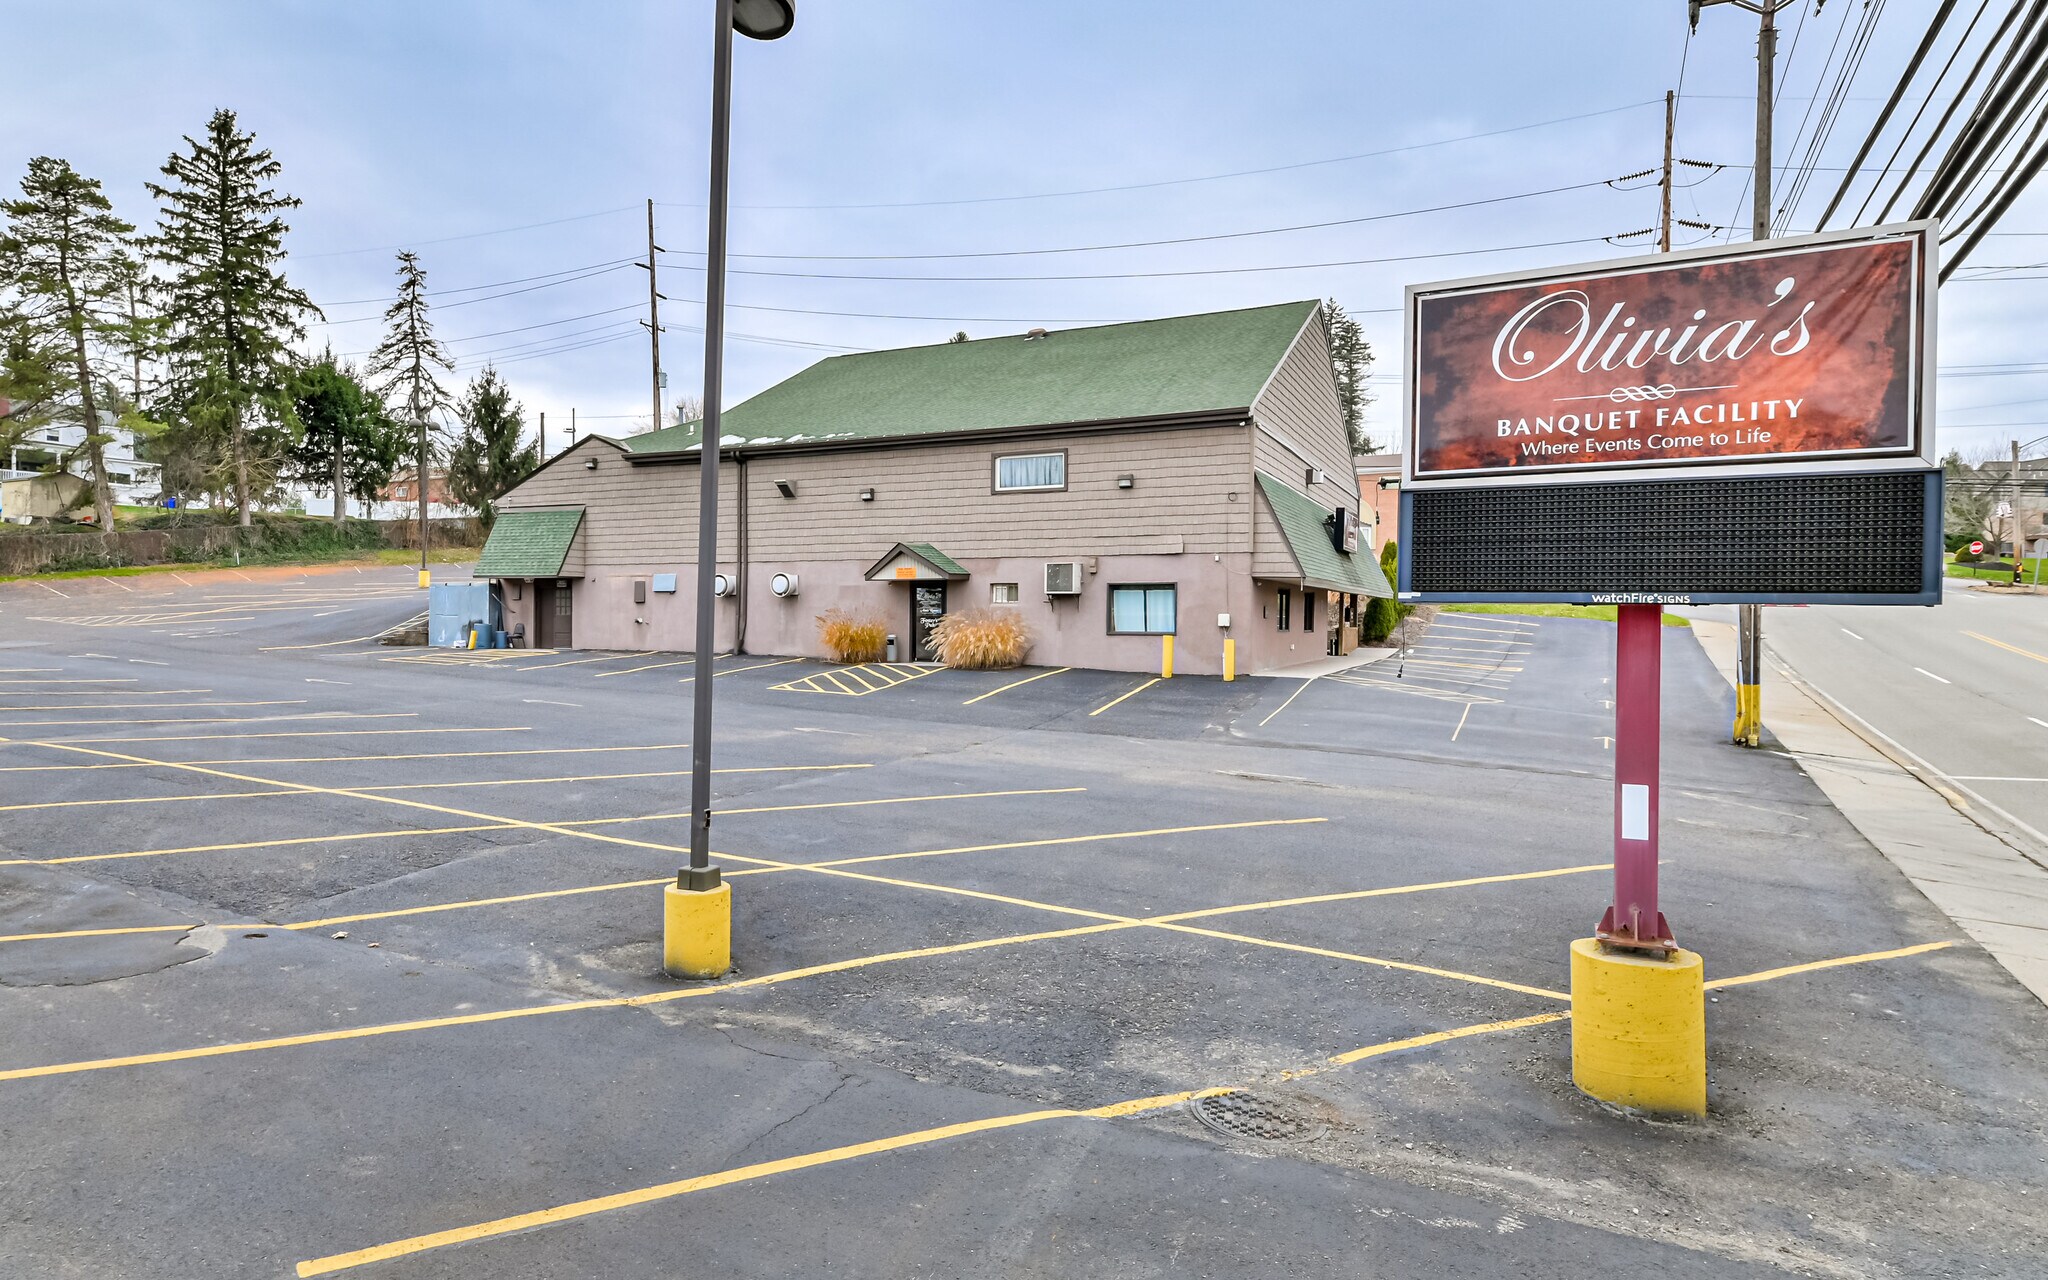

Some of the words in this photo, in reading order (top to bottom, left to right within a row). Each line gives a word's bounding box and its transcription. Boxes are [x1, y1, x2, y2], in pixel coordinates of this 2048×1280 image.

[1491, 276, 1816, 382] Olivia's
[1496, 409, 1642, 437] BANQUET
[1655, 398, 1804, 427] FACILITY
[1521, 440, 1580, 457] Where
[1585, 436, 1642, 453] Events
[1647, 433, 1704, 449] Come
[1709, 432, 1729, 446] to
[1735, 427, 1772, 444] Life
